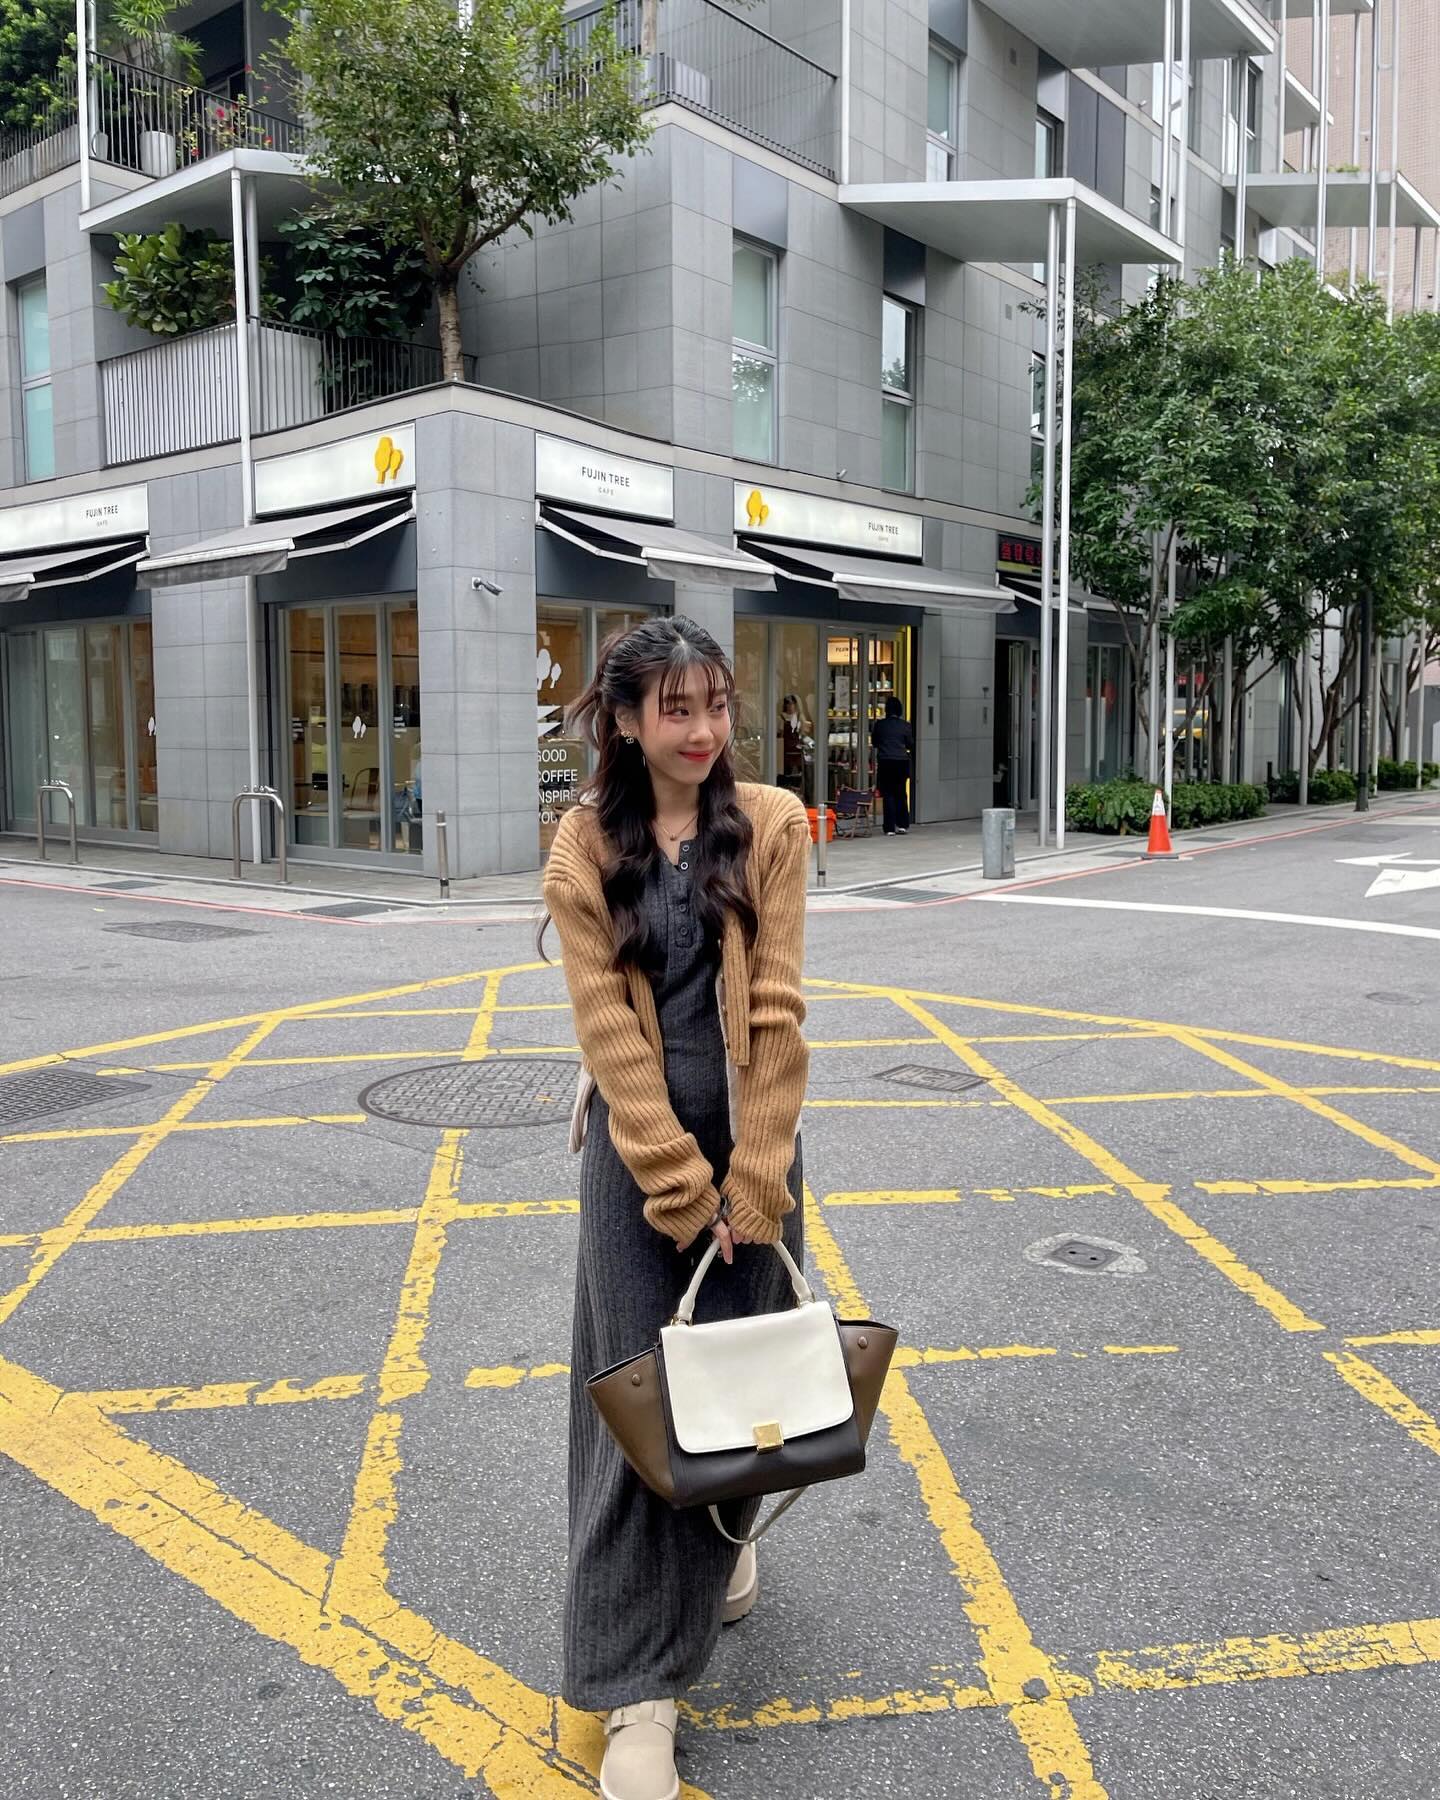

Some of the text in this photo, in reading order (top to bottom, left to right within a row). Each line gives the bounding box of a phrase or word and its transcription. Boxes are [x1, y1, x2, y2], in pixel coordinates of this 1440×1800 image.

[581, 466, 630, 487] FUJIN TREE
[103, 505, 118, 515] TREE
[537, 769, 578, 783] OFFEE
[537, 789, 577, 803] NSPIRE
